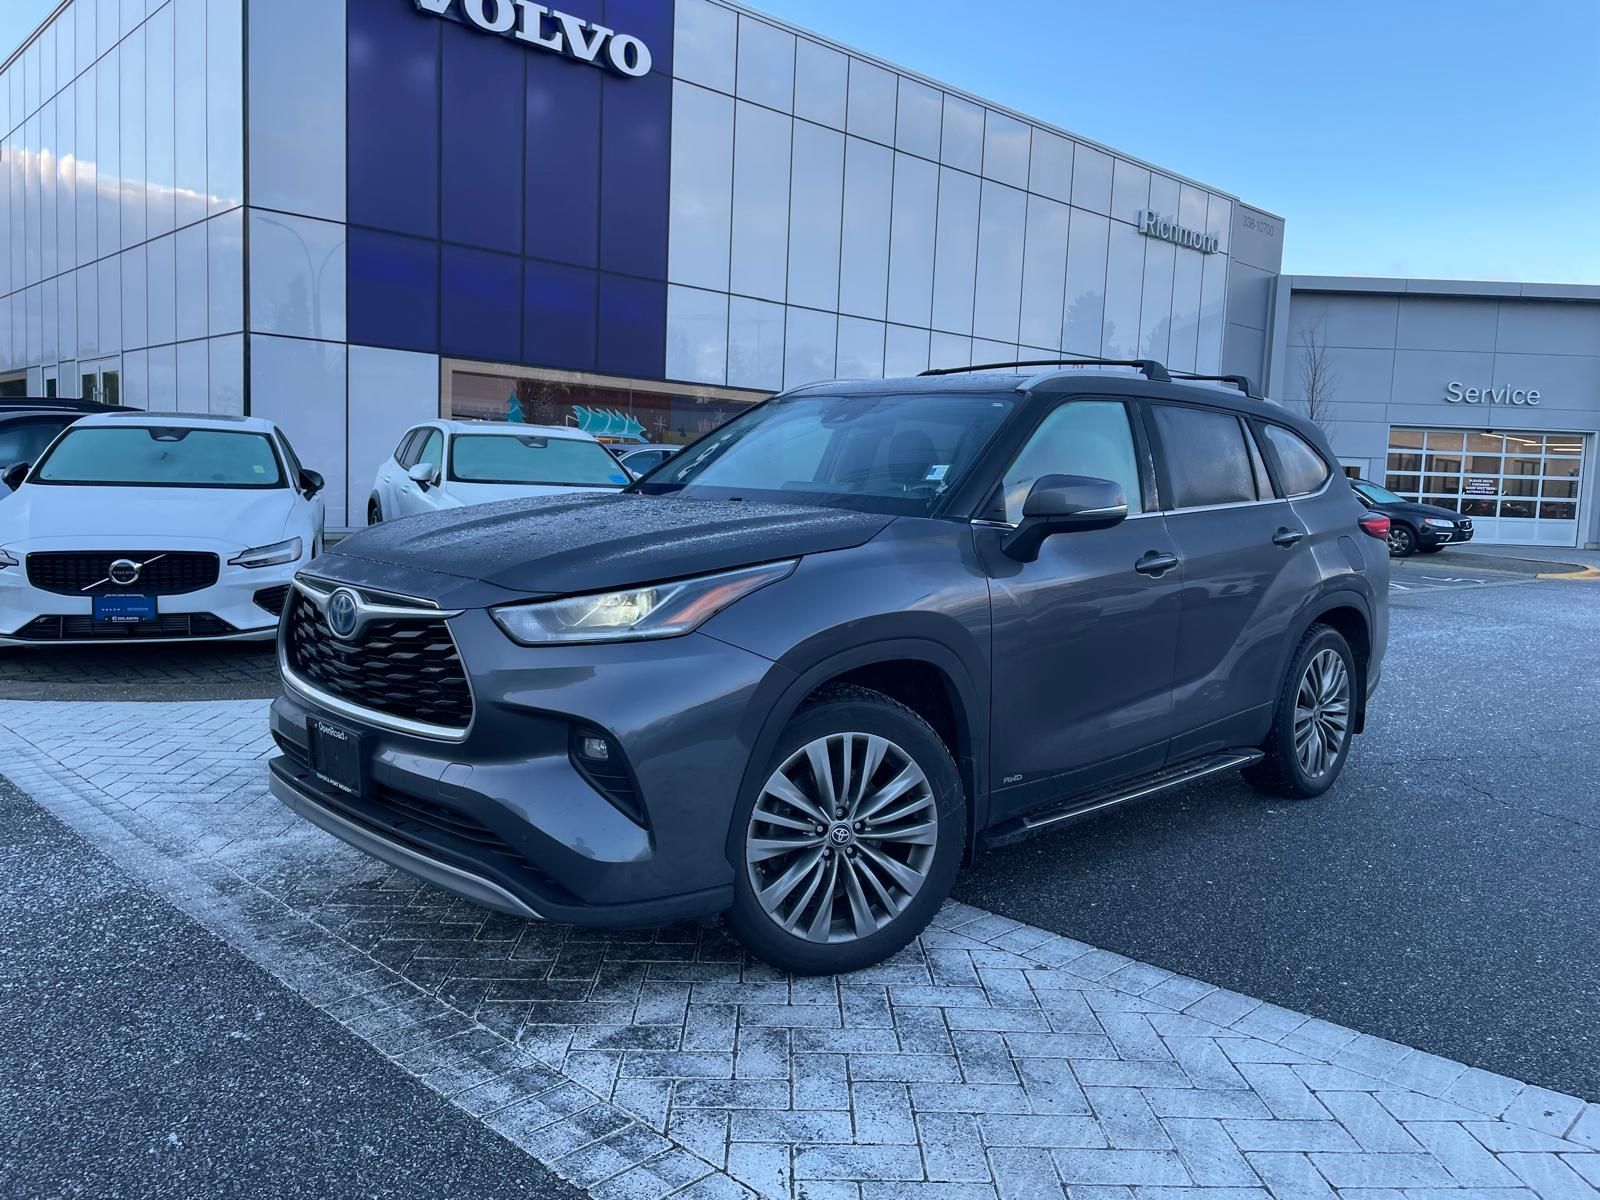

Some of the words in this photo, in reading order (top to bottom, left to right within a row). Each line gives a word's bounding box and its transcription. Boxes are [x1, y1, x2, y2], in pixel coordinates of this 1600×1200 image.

[413, 0, 652, 77] OLVO
[1138, 208, 1220, 254] Richmond
[1242, 214, 1274, 237] 338-10700
[1446, 381, 1541, 406] Service
[318, 721, 345, 740] OpenRoad
